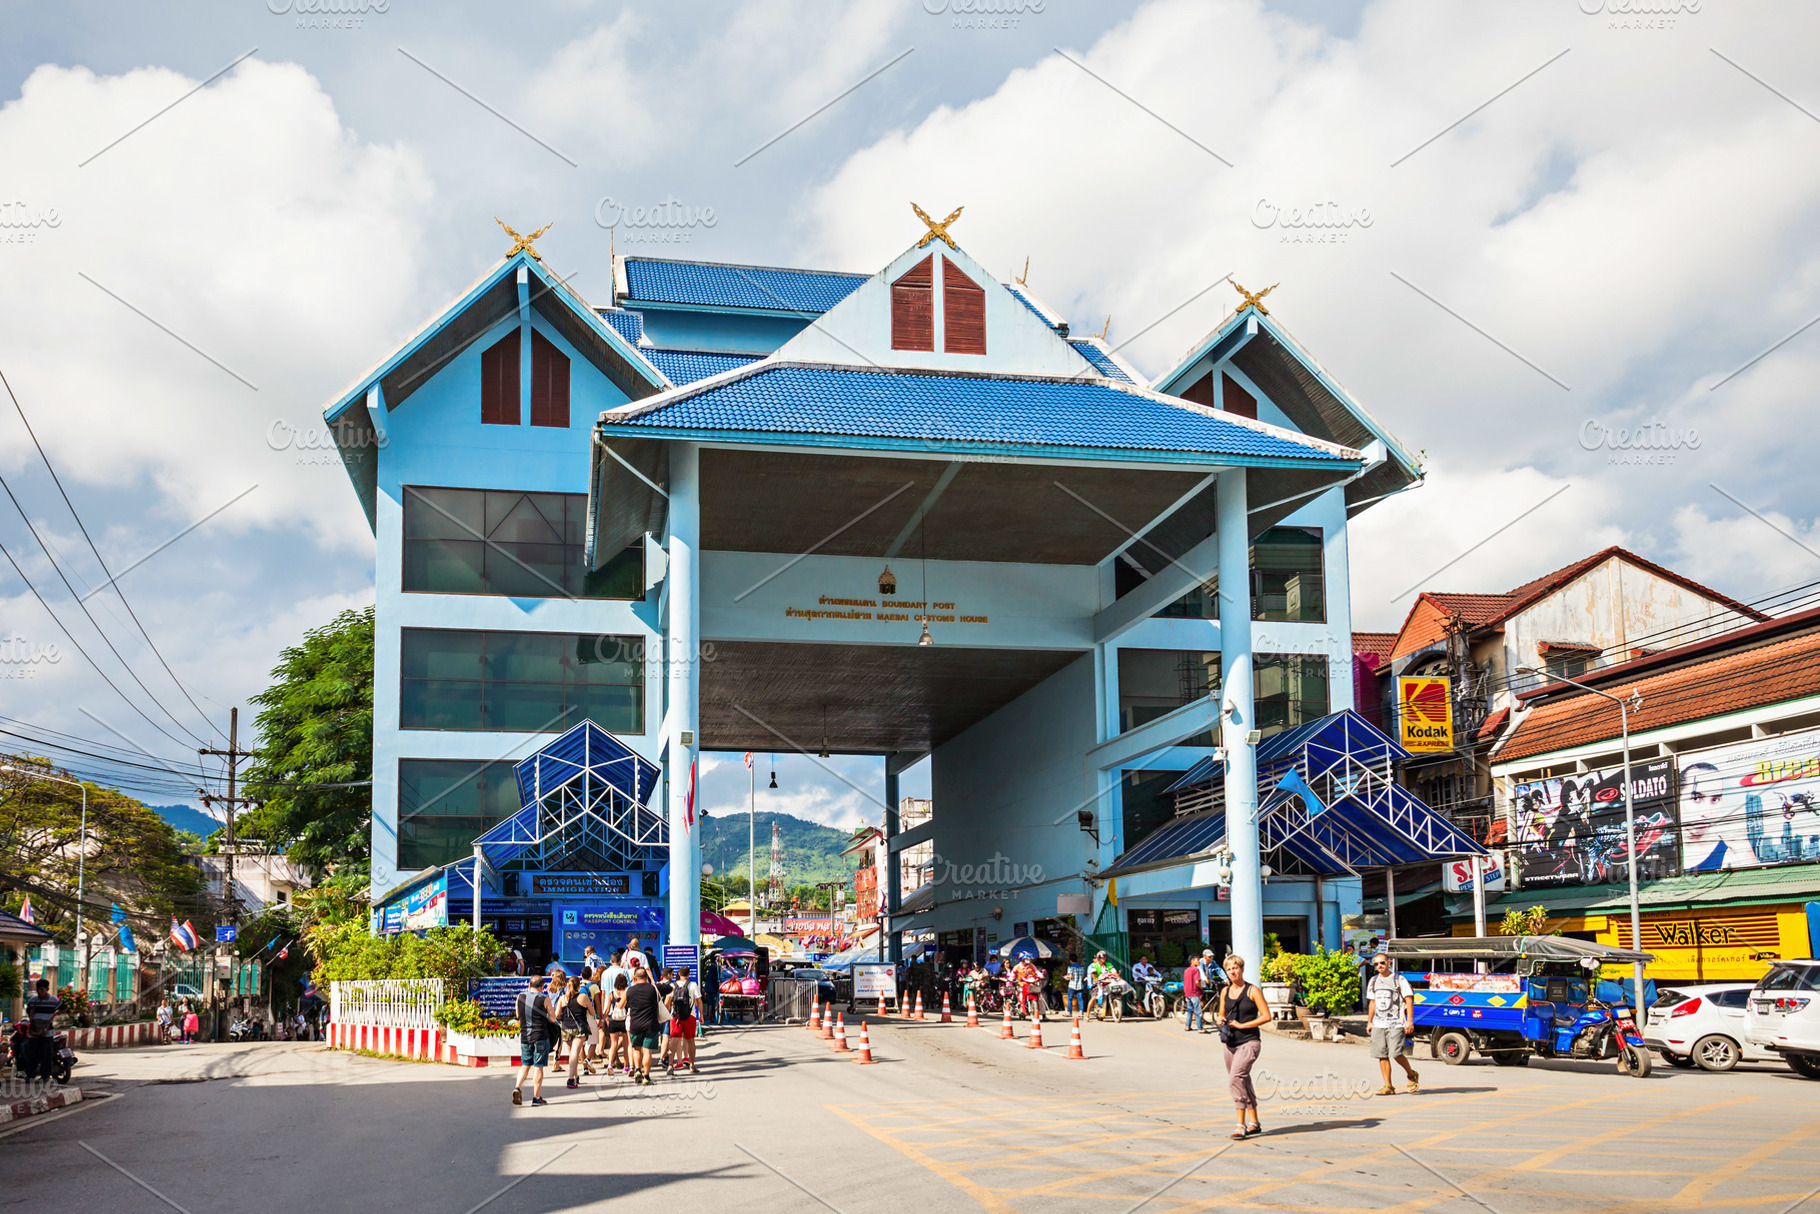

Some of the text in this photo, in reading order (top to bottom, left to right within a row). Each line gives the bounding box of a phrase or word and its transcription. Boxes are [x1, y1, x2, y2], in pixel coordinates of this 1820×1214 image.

[882, 600, 928, 610] BOUNDARY
[932, 602, 956, 610] POST
[876, 614, 910, 622] MAESAI
[960, 615, 989, 624] HOUSE
[1407, 725, 1449, 738] Kodak
[539, 875, 624, 887] ตรวจคนเข้าเมือง
[1485, 871, 1500, 882] STEP
[1655, 921, 1736, 945] Walker
